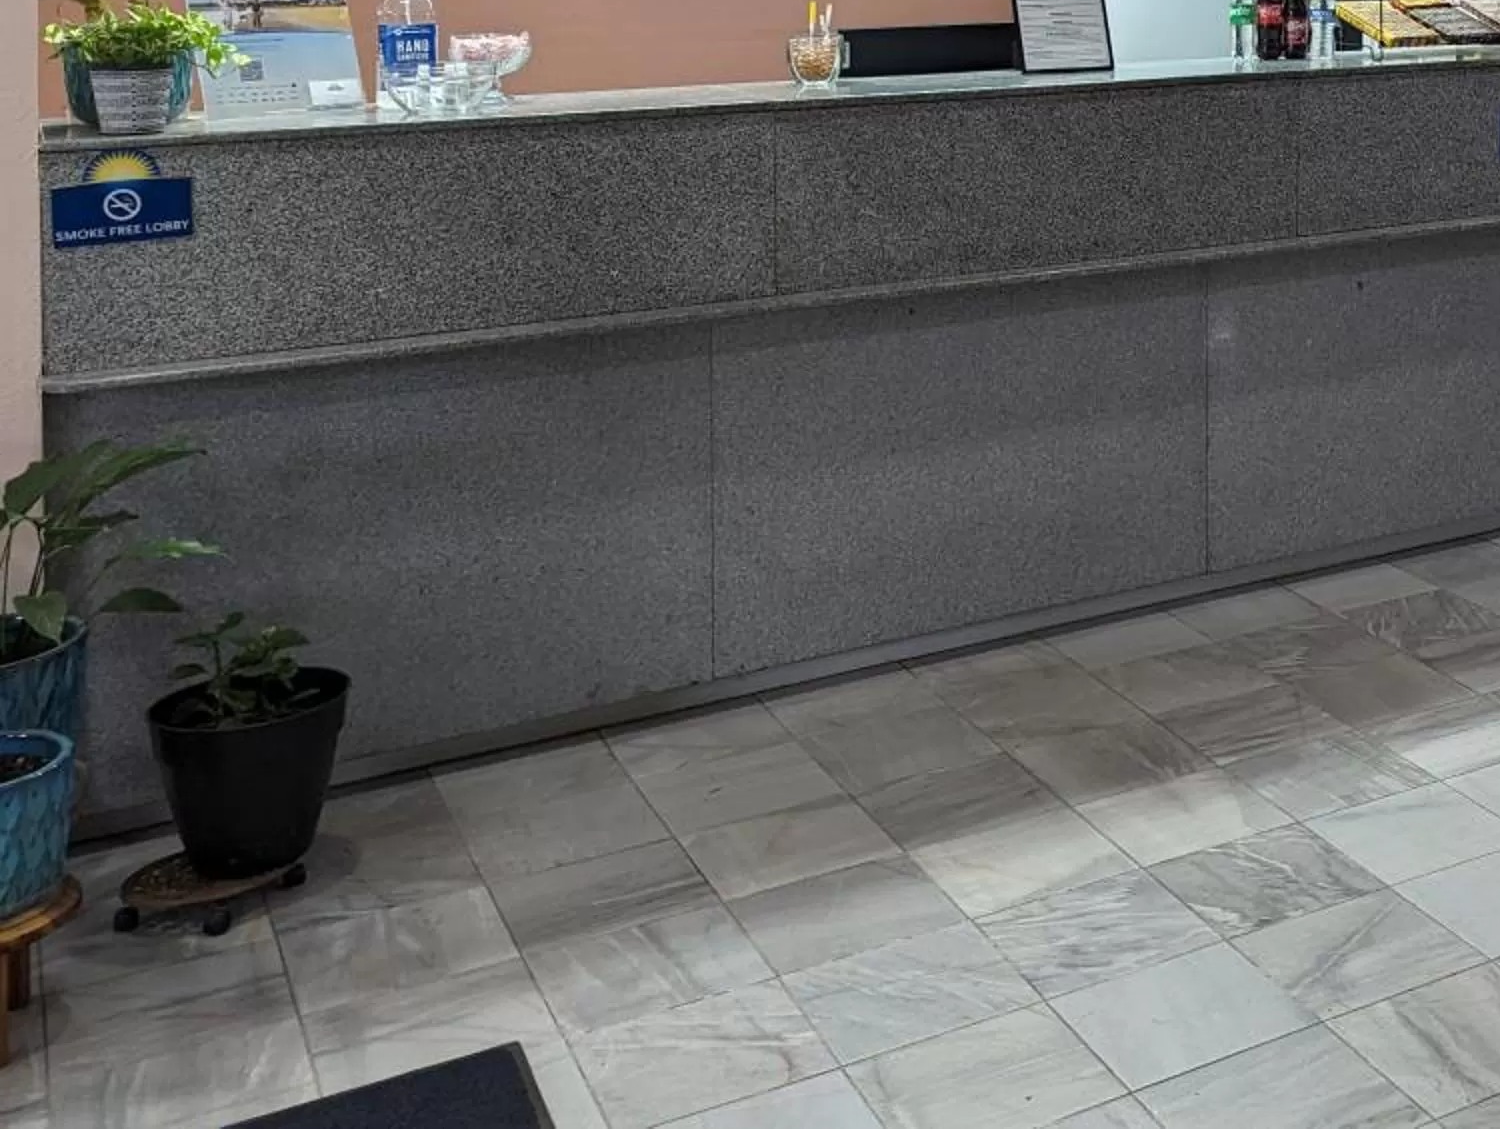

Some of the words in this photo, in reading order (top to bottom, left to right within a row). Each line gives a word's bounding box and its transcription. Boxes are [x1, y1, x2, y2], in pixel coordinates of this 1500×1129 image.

[395, 38, 430, 53] HAND
[55, 226, 107, 242] SMOKE
[108, 224, 144, 237] FREE
[145, 219, 190, 234] LOBBY
